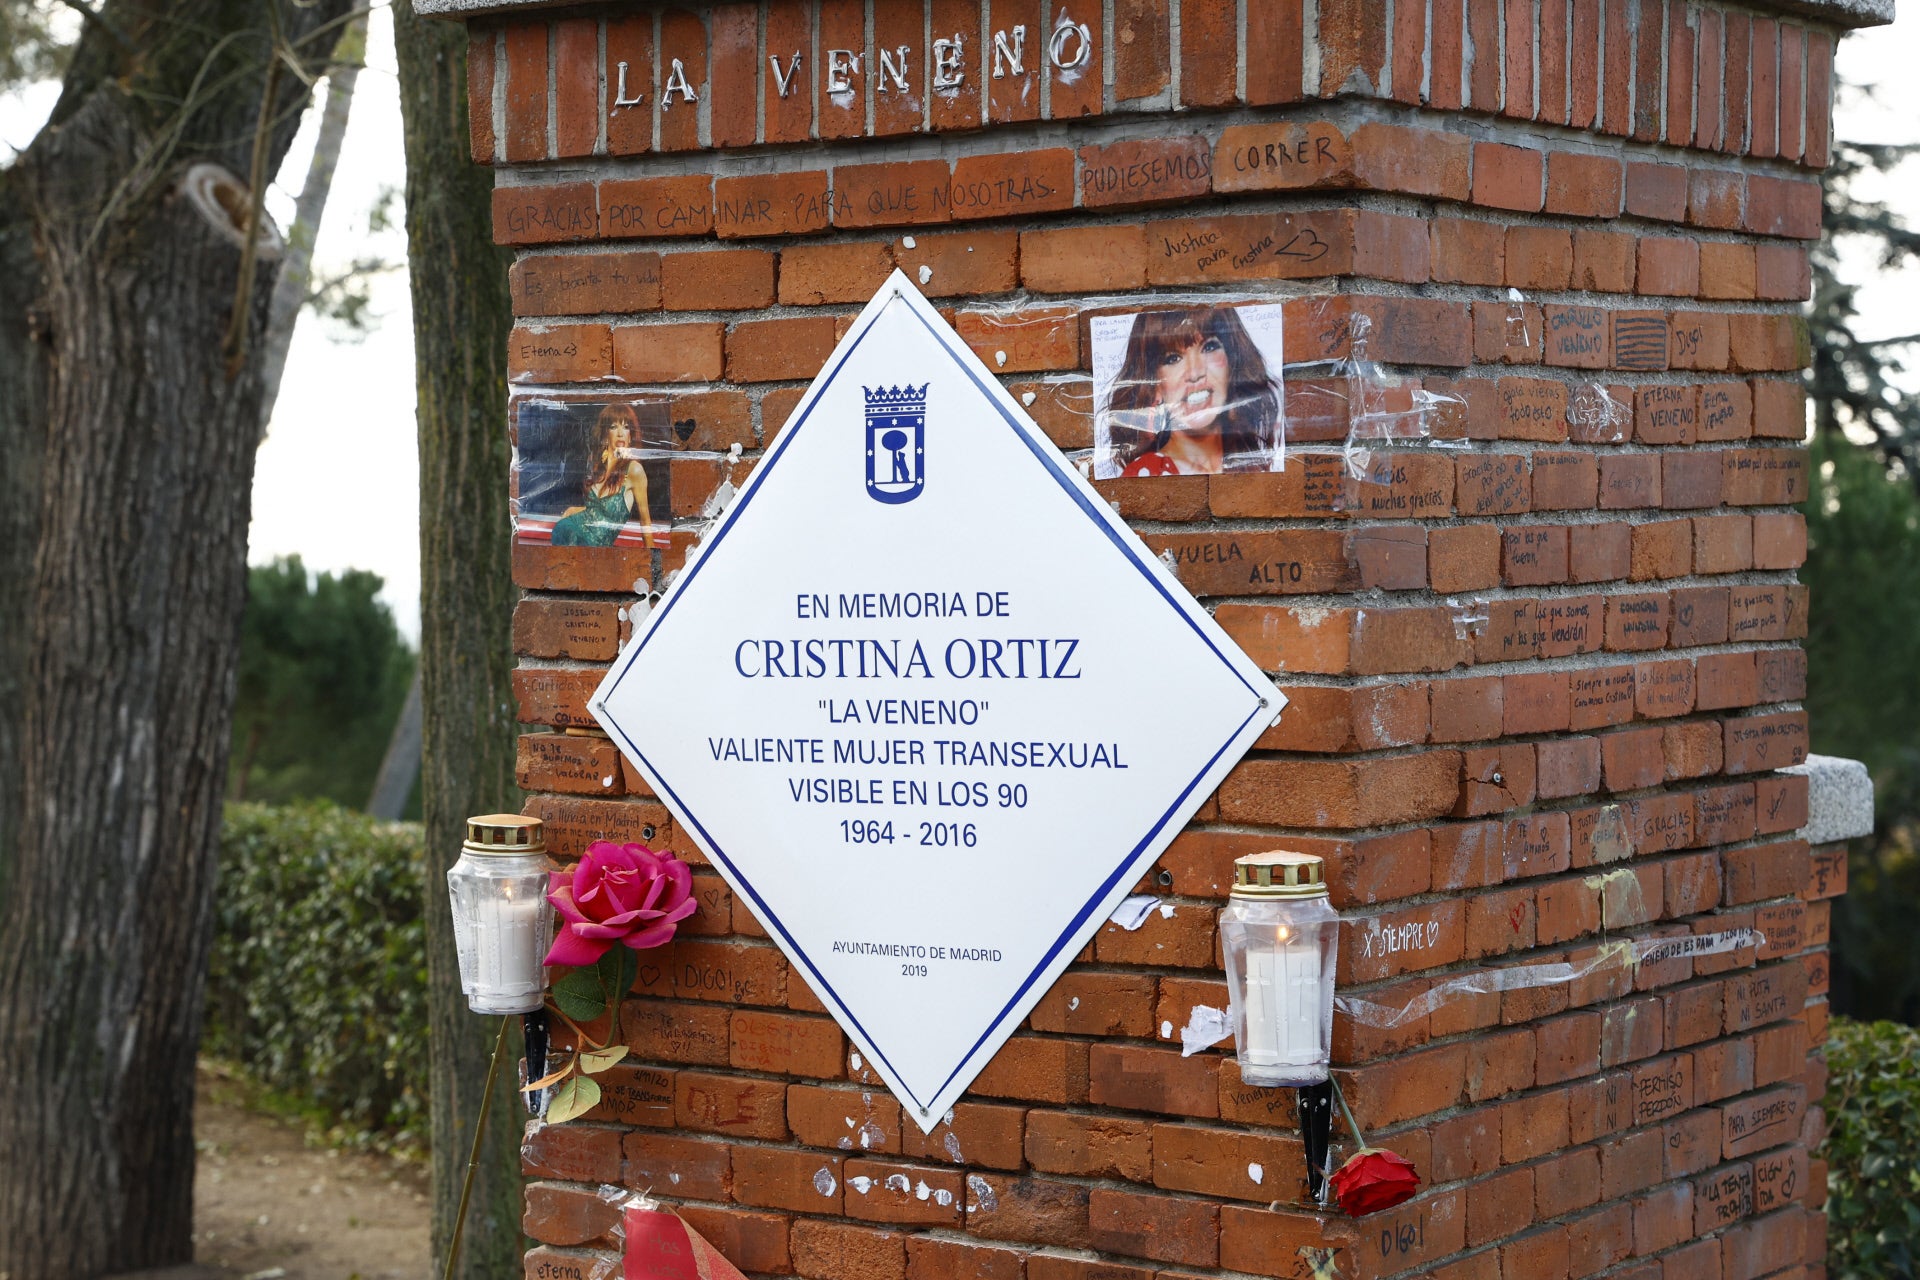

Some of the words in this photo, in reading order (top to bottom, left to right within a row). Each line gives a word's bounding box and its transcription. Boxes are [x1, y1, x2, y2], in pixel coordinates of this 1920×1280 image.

[614, 57, 698, 107] LA
[768, 22, 1091, 98] VENENO
[508, 205, 595, 233] GRACIAS
[608, 203, 645, 230] POR
[656, 195, 773, 230] CAMINAR
[796, 189, 854, 224] PARA
[867, 187, 919, 215] QUE
[1234, 136, 1338, 172] CORRER
[1164, 231, 1220, 258] Justicia
[1197, 248, 1229, 271] para
[1643, 387, 1682, 408] ETERNA
[1510, 403, 1531, 424] todo
[1532, 405, 1553, 422] esto
[1650, 409, 1694, 428] VENENO
[1172, 541, 1244, 565] VUELA
[1249, 561, 1302, 584] ALTO
[797, 594, 829, 619] EN
[839, 592, 968, 619] MEMORIA
[976, 591, 1010, 617] DE
[1733, 596, 1742, 608] te
[1514, 604, 1530, 626] por
[1535, 603, 1547, 619] las
[1550, 606, 1563, 630] que
[1503, 633, 1513, 652] por
[1518, 630, 1528, 645] las
[1531, 631, 1547, 651] que
[1551, 621, 1588, 644] vendrán!
[734, 638, 935, 679] CRISTINA
[944, 638, 1082, 679] ORTIZ
[1576, 676, 1601, 694] Siempre
[818, 699, 861, 724] "LA
[866, 699, 989, 725] VENENO"
[551, 743, 562, 752] TE
[708, 737, 825, 764] VALIENTE
[833, 739, 925, 765] MUJER
[934, 740, 1129, 769] TRANSEXUAL
[788, 778, 884, 804] VISIBLE
[893, 780, 928, 806] EN
[937, 781, 990, 807] LOS
[998, 783, 1029, 808] 90
[590, 812, 601, 825] en
[604, 811, 641, 829] Madrid
[1517, 823, 1528, 838] TE
[1643, 810, 1691, 837] GRACIAS
[840, 819, 896, 844] 1964
[919, 821, 978, 848] 2016
[1580, 832, 1589, 845] LA
[562, 841, 570, 852] a
[832, 941, 926, 959] AYUNTAMIENTO
[929, 946, 946, 960] DE
[950, 948, 1002, 962] MADRID
[1363, 932, 1374, 958] X
[1640, 946, 1670, 967] VENENO
[1671, 943, 1681, 955] DE
[684, 964, 733, 990] DIGO!
[901, 964, 928, 977] 2019
[1737, 984, 1745, 1000] NI
[1750, 977, 1770, 1001] PUTA
[1741, 1007, 1750, 1022] NI
[1755, 994, 1786, 1019] SANTA
[615, 1085, 625, 1095] SE
[1605, 1084, 1617, 1106] NI
[1638, 1070, 1683, 1099] PERMISO
[1606, 1112, 1617, 1130] NI
[1638, 1093, 1682, 1118] PERDÓN
[1728, 1115, 1746, 1138] PARA
[1751, 1100, 1786, 1126] SIEMPRE
[537, 1262, 582, 1280] eterna
